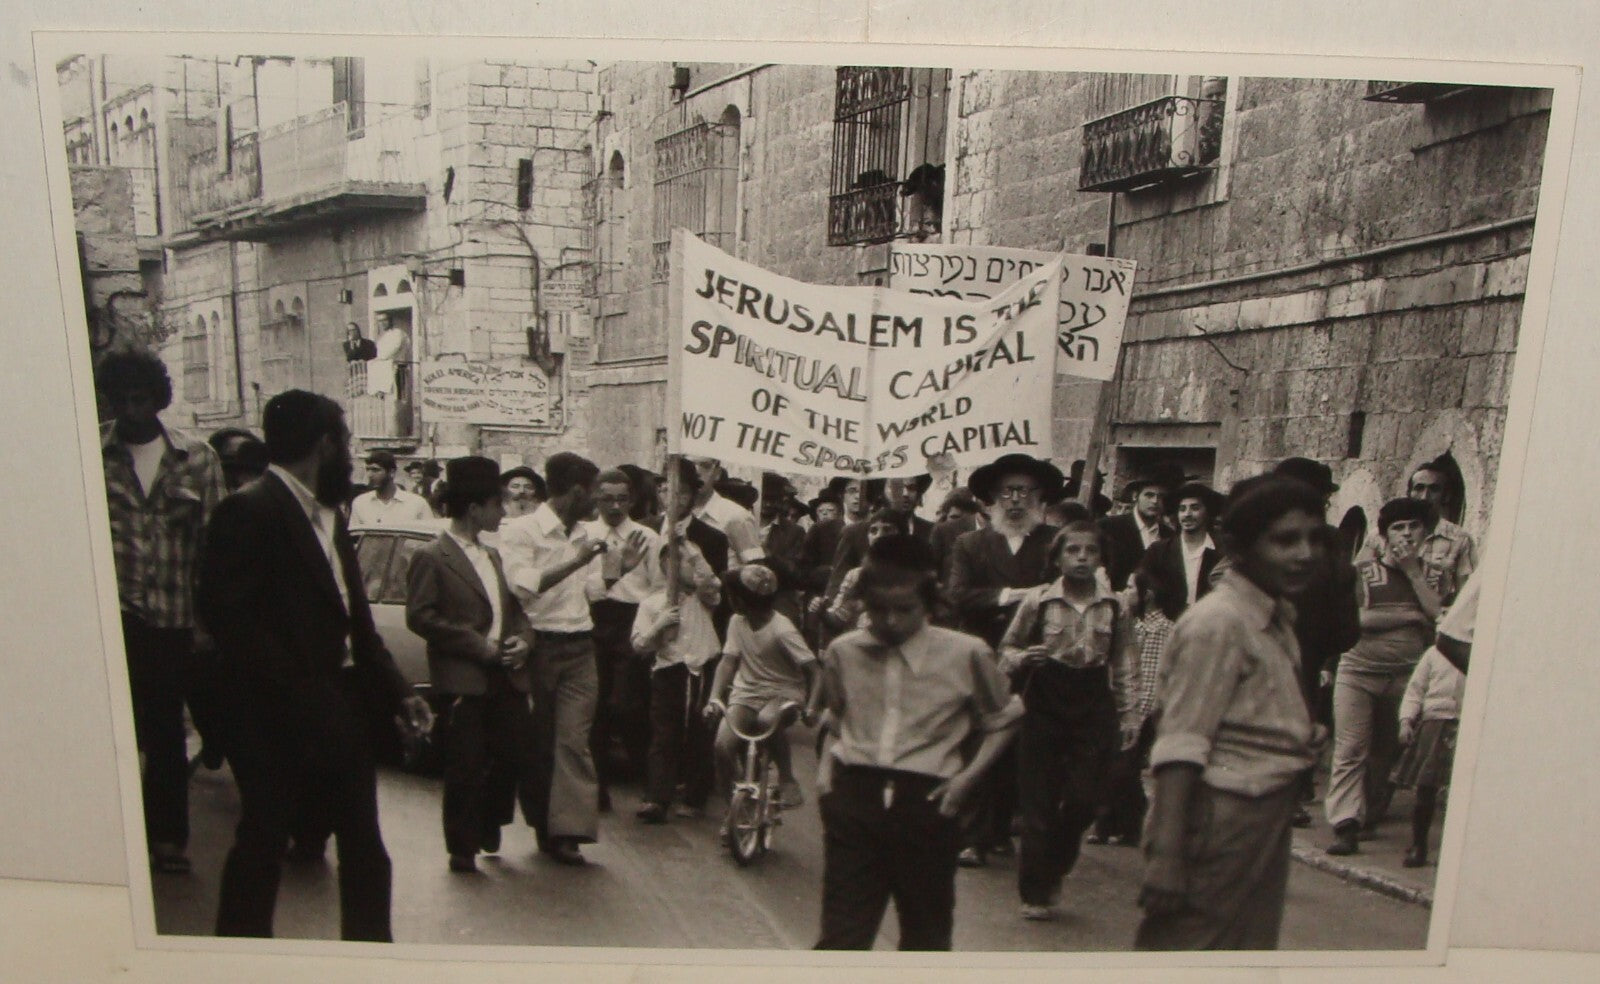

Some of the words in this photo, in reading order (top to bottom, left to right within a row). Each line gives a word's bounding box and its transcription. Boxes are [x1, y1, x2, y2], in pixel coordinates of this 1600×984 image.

[695, 268, 923, 348] JERUSALEM
[943, 314, 977, 346] IS
[991, 279, 1048, 324] THE
[1083, 266, 1125, 296] אנו
[685, 320, 867, 402] SPIRITUAL
[889, 331, 1035, 400] CAPITAL
[682, 412, 725, 442] NOT
[737, 422, 791, 458] THE
[793, 440, 909, 474] SPORTS
[920, 419, 1039, 459] CAPITAL
[752, 388, 790, 417] OF
[804, 408, 860, 443] THE
[877, 396, 972, 443] WORLD
